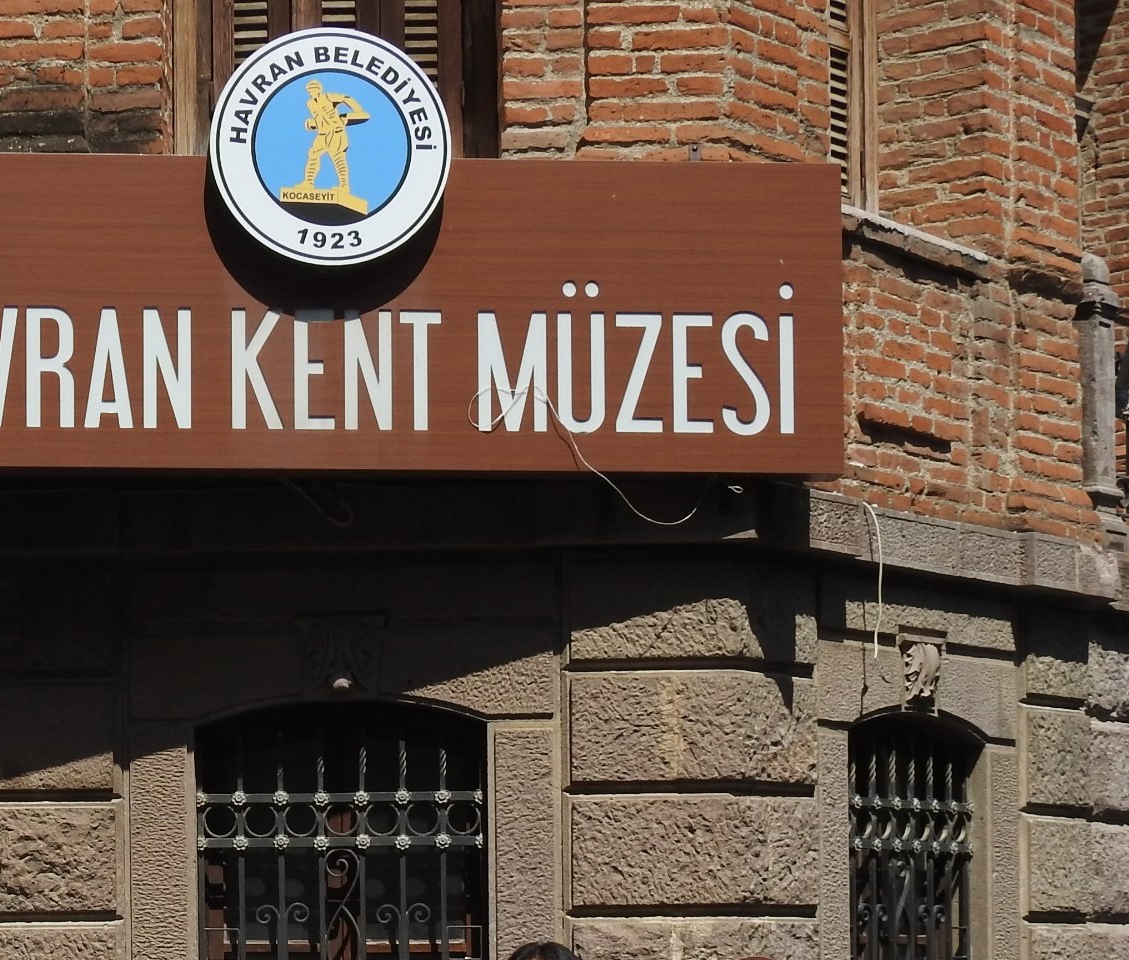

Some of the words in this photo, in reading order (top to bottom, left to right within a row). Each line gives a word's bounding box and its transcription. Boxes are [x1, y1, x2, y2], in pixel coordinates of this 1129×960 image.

[229, 51, 305, 144] HAVRAN
[313, 46, 438, 151] BELEDİYESİ
[281, 191, 336, 201] KOCASEYİT
[297, 228, 363, 249] 1923
[231, 310, 442, 431] KENT
[478, 282, 795, 436] MÜZESİ
